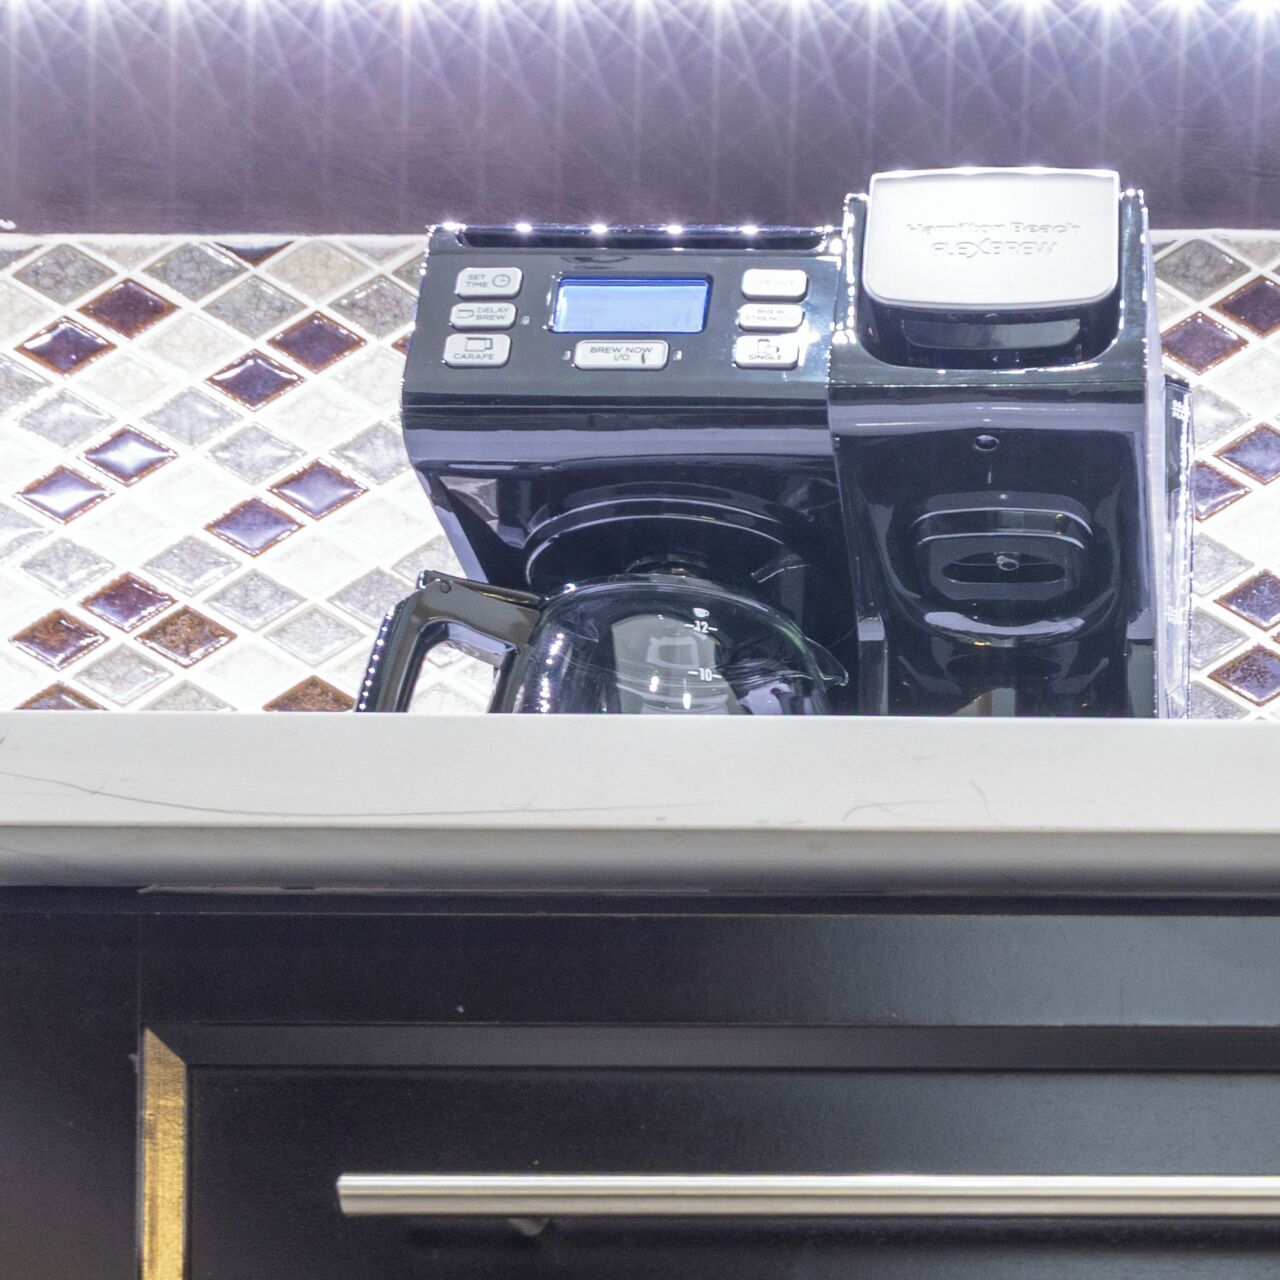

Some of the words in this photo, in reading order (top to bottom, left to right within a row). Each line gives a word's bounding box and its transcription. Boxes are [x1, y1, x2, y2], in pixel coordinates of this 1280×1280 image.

[589, 346, 623, 354] BREW
[625, 346, 654, 354] NOW
[453, 352, 495, 360] CARAFE
[694, 620, 709, 633] 12
[699, 667, 713, 681] 10
